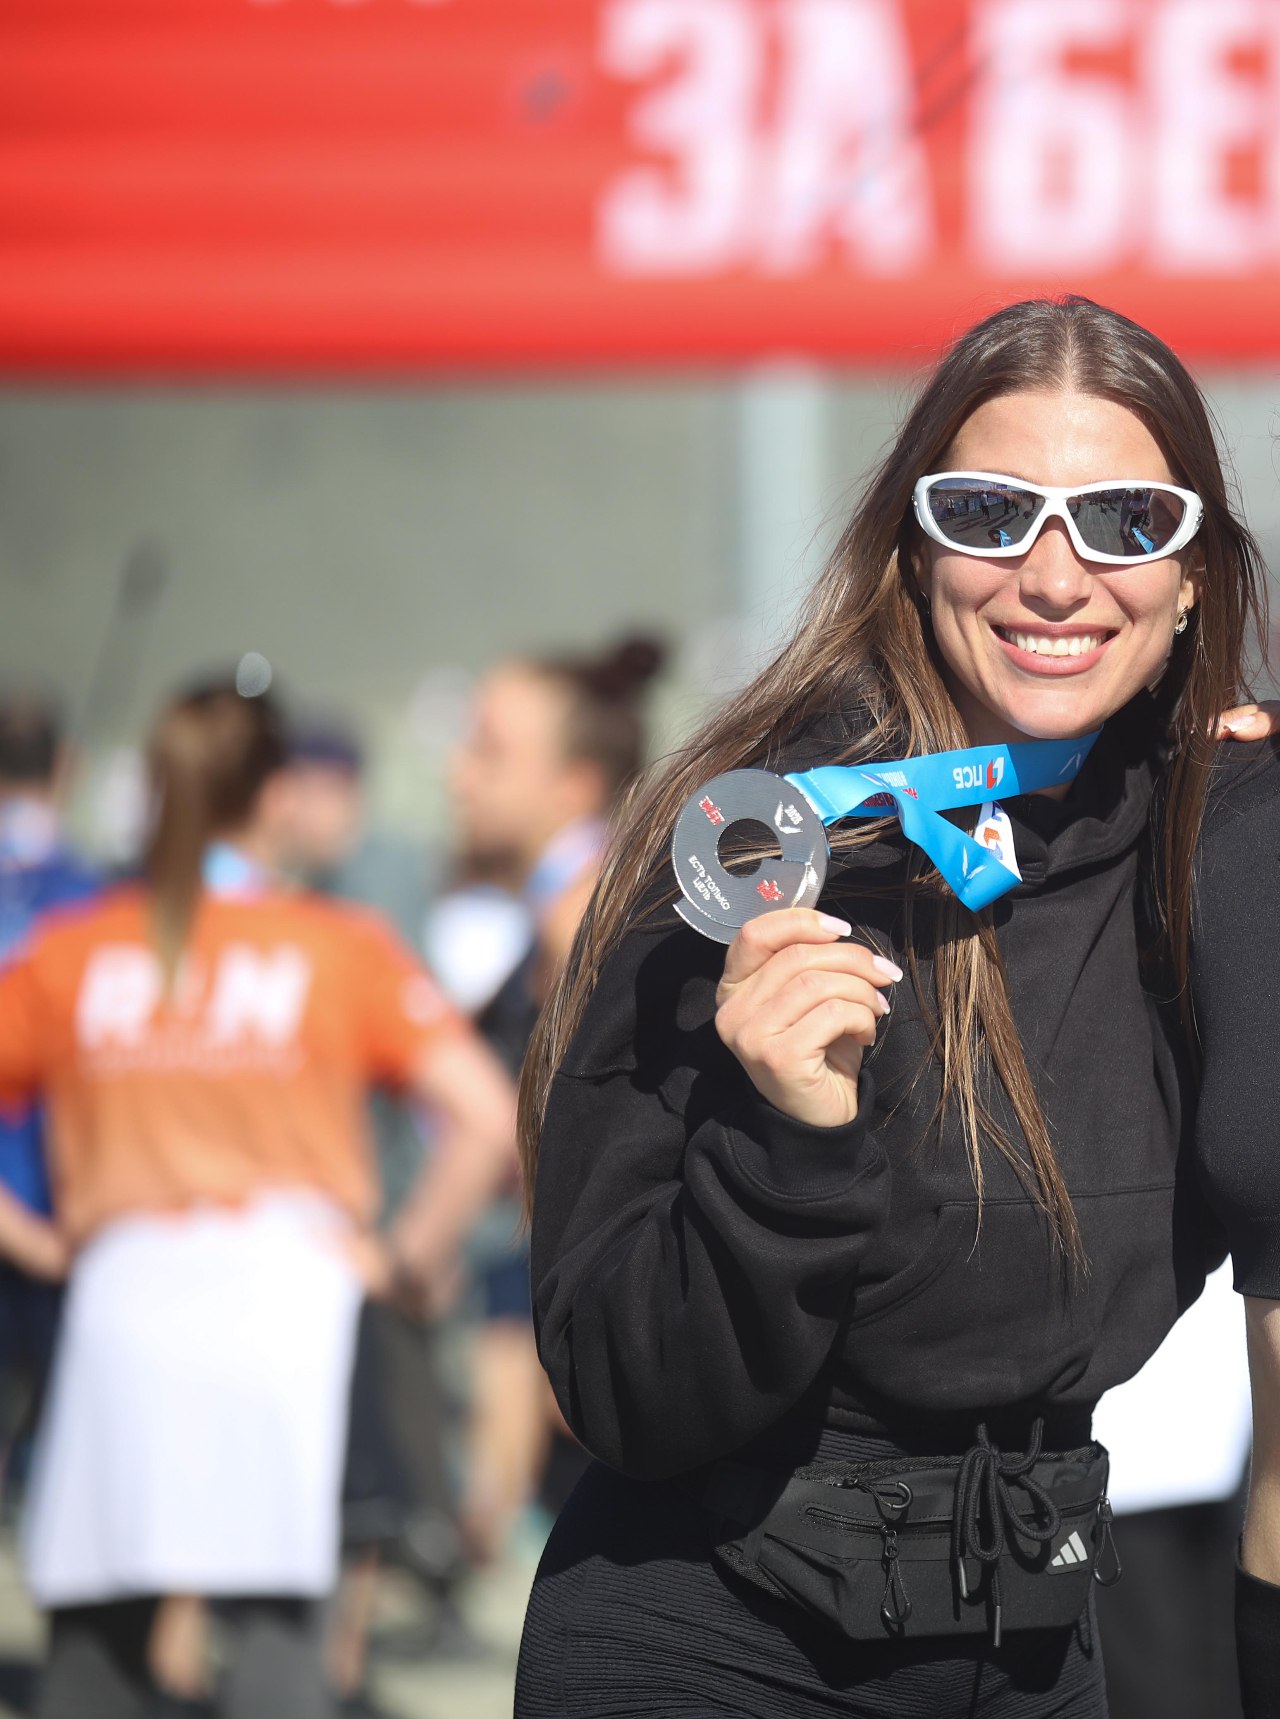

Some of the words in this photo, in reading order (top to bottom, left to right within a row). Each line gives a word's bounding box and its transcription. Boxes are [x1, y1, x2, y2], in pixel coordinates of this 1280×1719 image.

[953, 764, 983, 789] ПСБ
[687, 854, 706, 878] ЕСТЬ
[704, 873, 731, 911] ТОЛЬКО
[692, 876, 711, 902] ЦЕЛЬ
